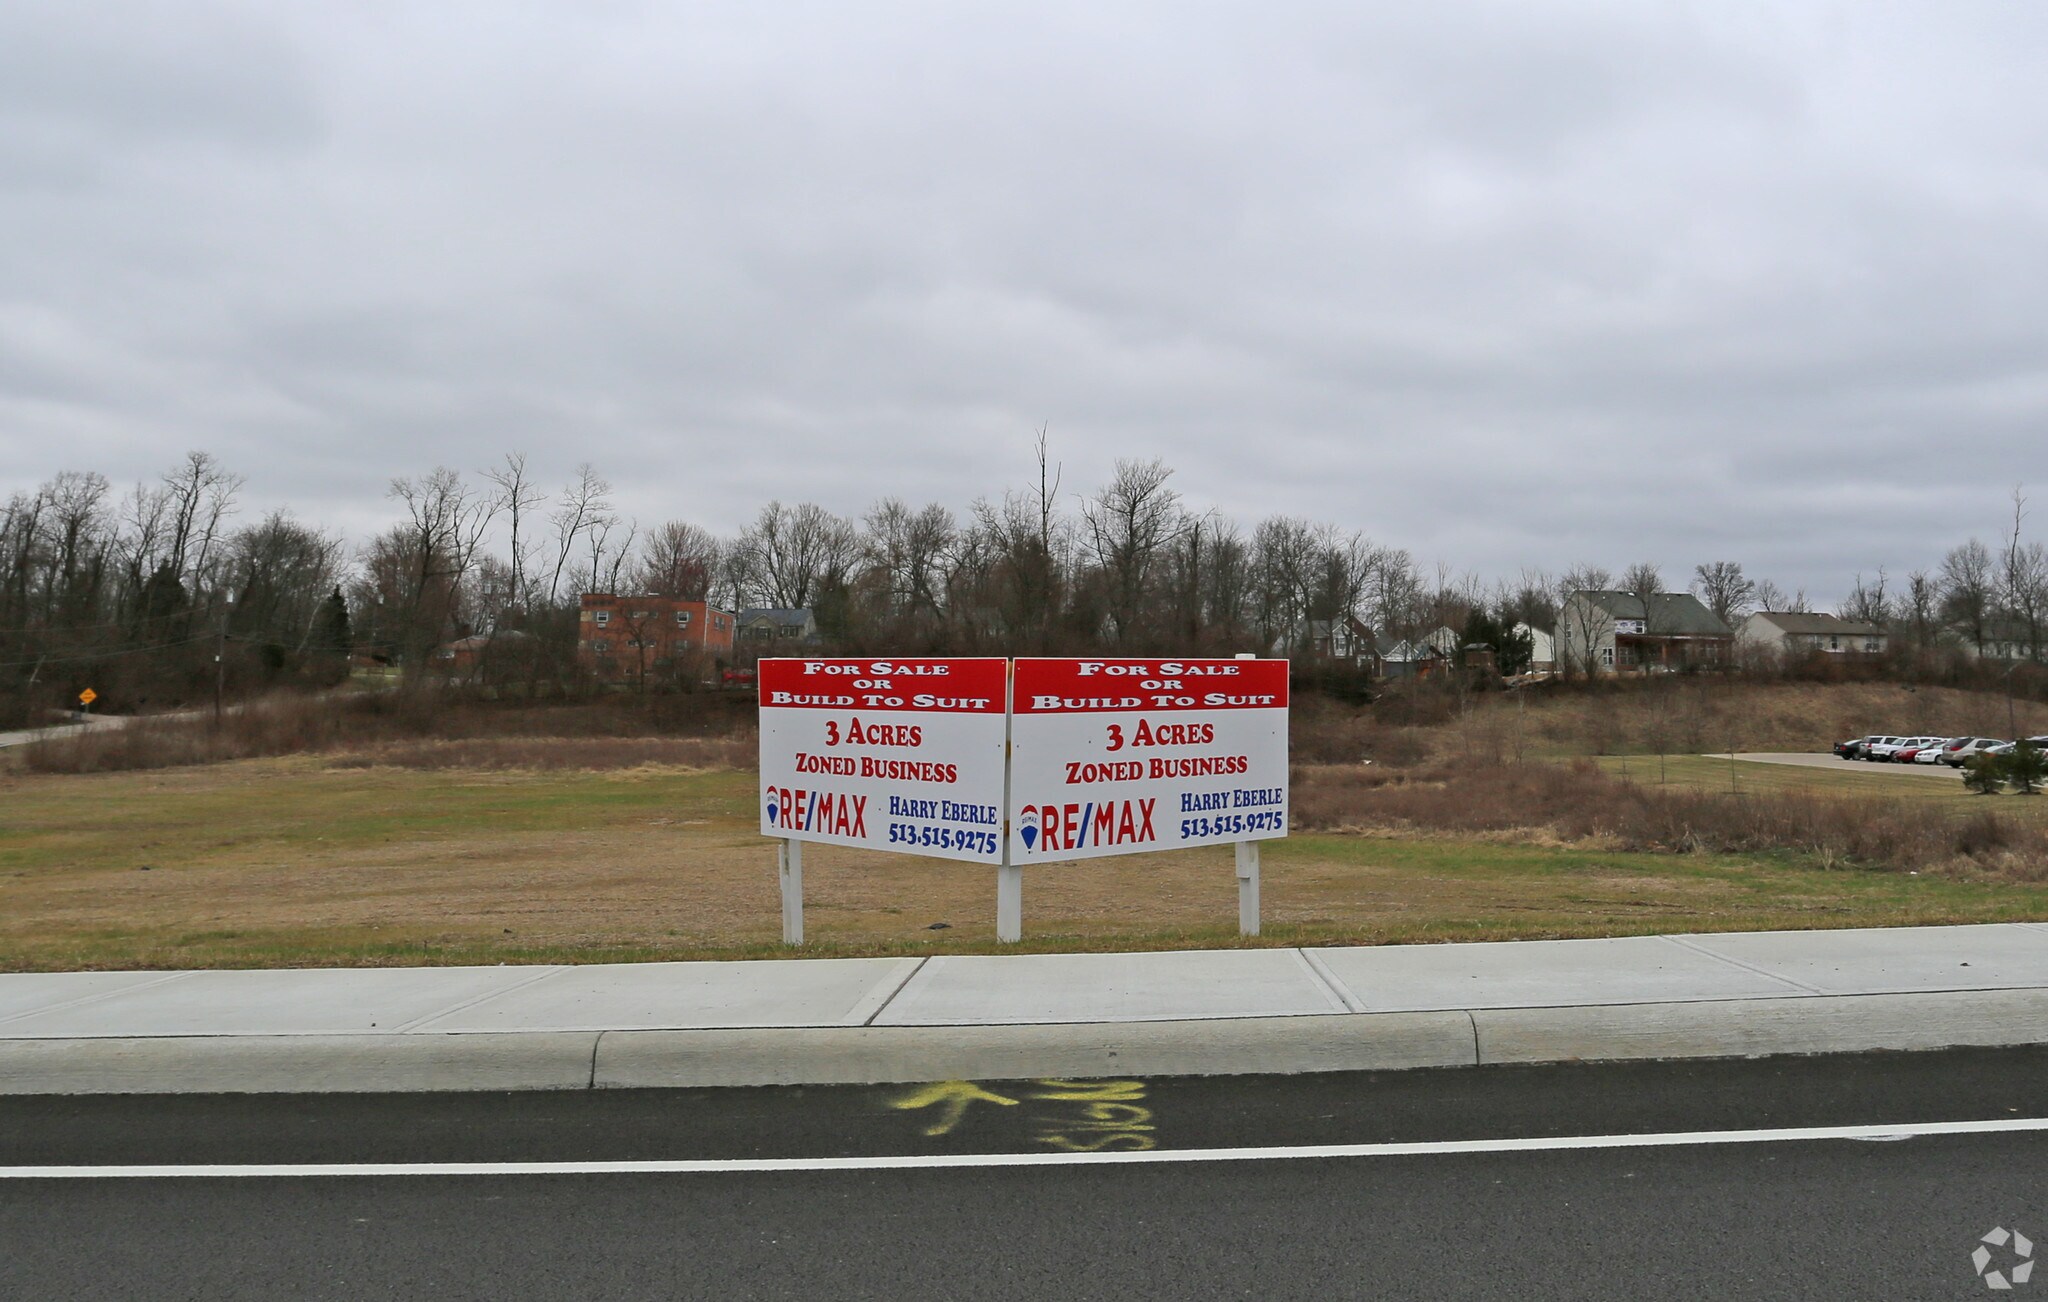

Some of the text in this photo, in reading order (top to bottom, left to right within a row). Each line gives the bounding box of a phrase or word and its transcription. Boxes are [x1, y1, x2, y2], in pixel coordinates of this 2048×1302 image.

[803, 662, 950, 675] FOR SALE
[1077, 662, 1240, 676] FOR SALE
[852, 679, 892, 689] OR
[1140, 679, 1183, 690] OR
[771, 692, 990, 709] BUILD TO SUIT
[1031, 693, 1275, 709] BUILD TO SUIT
[825, 717, 922, 747] 3 ACRES
[1106, 719, 1214, 751] 3 ACRES
[796, 753, 957, 784] ZONED BUSINESS
[1066, 756, 1248, 784] ZONED BUSINESS
[780, 788, 867, 838] RE/MAX
[889, 796, 997, 824] HARRY EBERLE
[1181, 788, 1283, 812] HARRY EBERLE
[889, 823, 997, 854] 513.515.9275
[1041, 798, 1156, 852] RE/MAX
[1181, 811, 1282, 839] 513.515.9275
